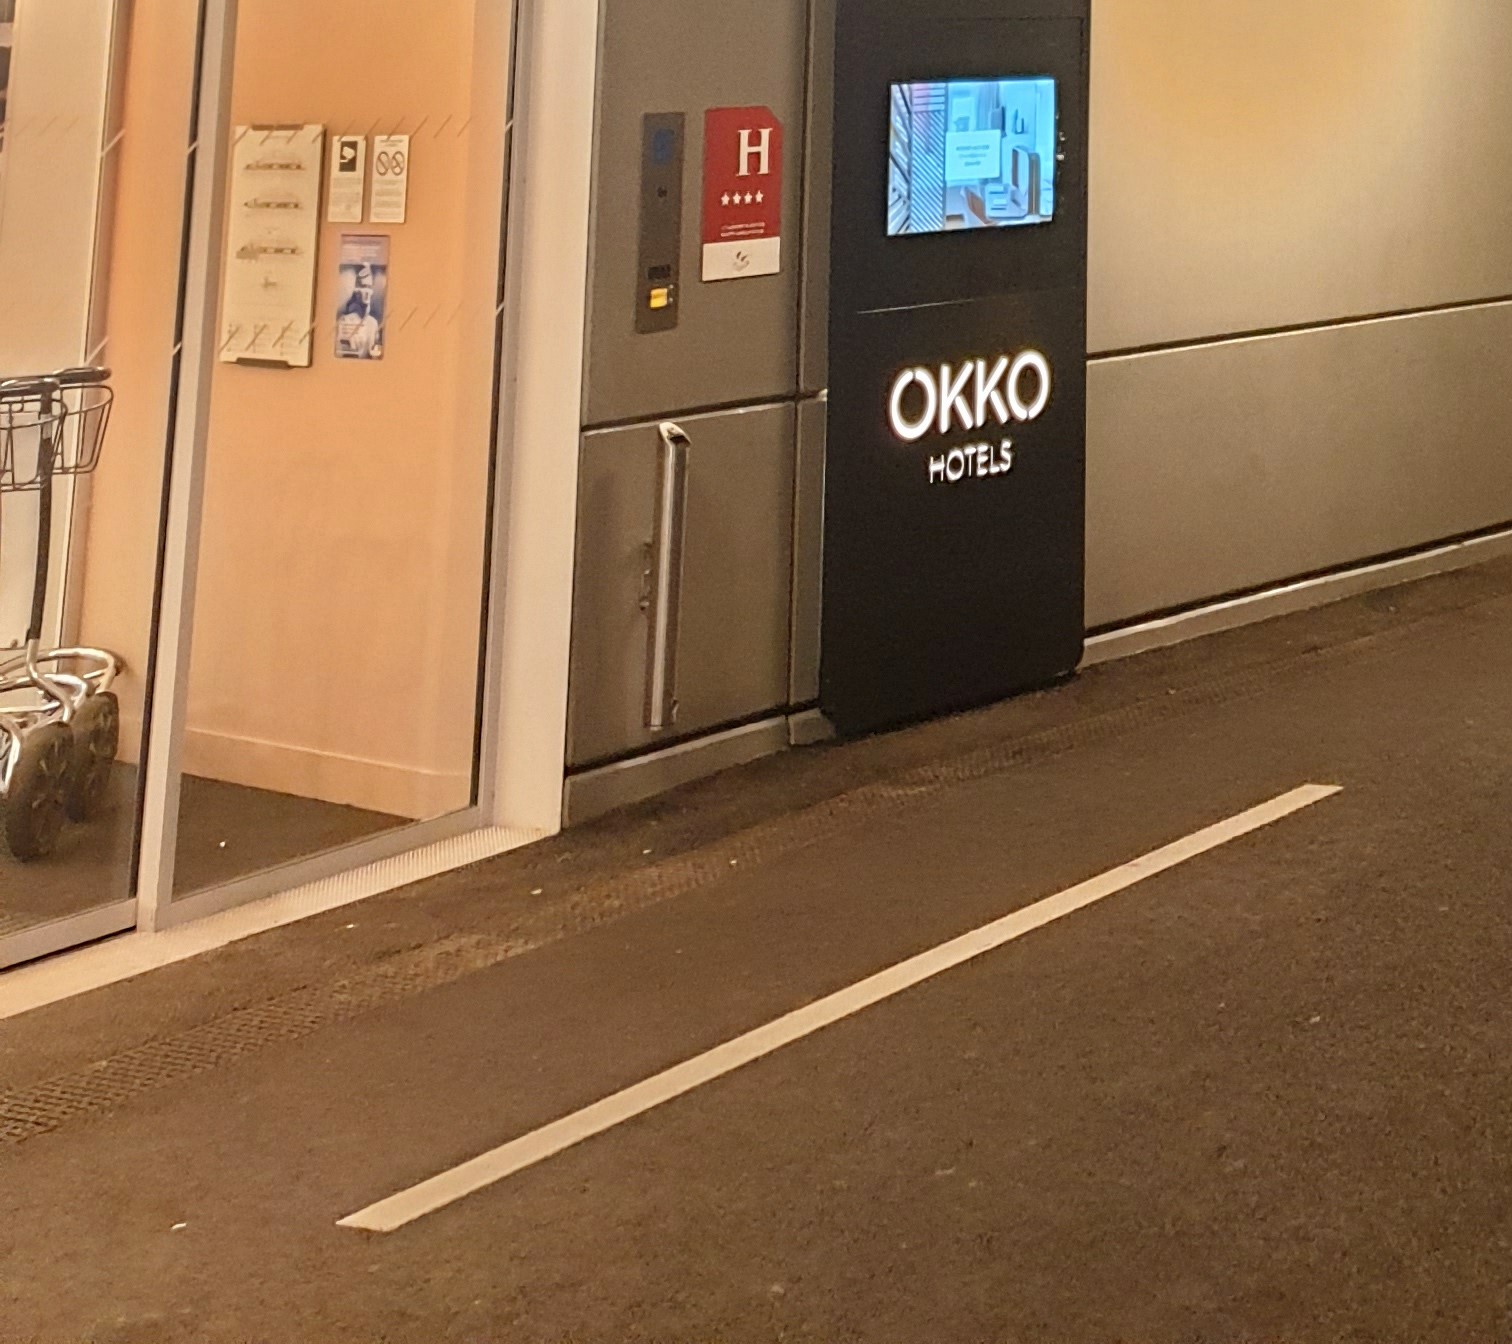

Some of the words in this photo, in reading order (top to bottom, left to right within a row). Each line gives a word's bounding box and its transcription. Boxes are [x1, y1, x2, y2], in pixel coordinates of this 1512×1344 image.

[736, 127, 774, 177] H
[889, 350, 1050, 441] OKKO
[928, 439, 1014, 484] HOTELS
